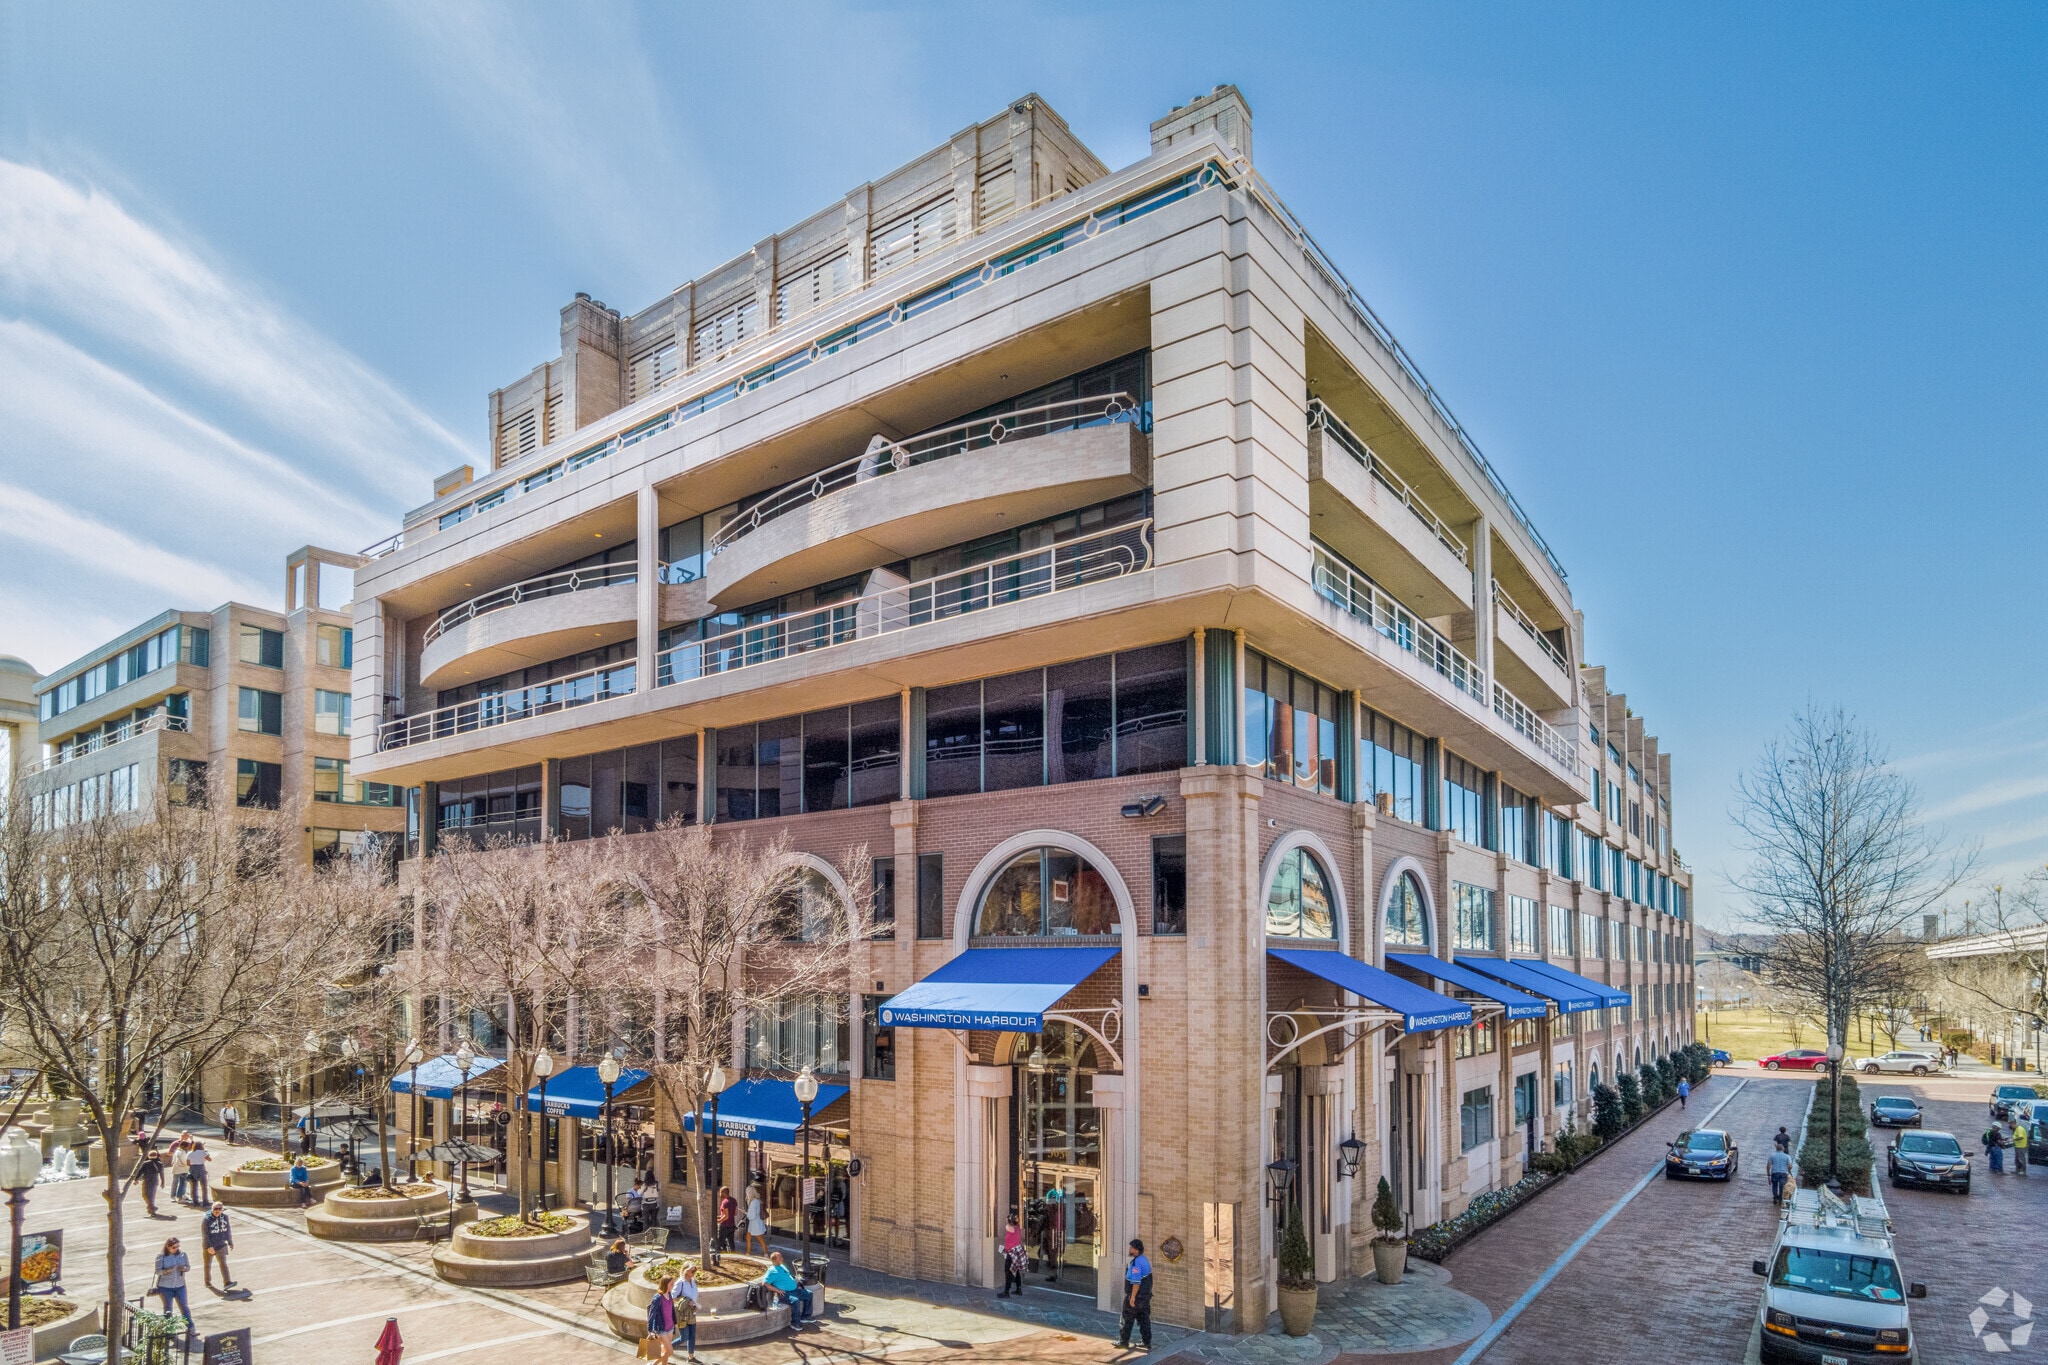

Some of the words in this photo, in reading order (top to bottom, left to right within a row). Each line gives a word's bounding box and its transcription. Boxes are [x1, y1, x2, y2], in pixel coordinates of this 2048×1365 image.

[895, 1012, 971, 1025] WASHINGTON
[974, 1015, 1037, 1027] HARBOUR
[1415, 1015, 1448, 1026] WASHINGTON
[1448, 1011, 1471, 1021] HARBOUR
[543, 1100, 571, 1110] TARBUCKS
[546, 1107, 565, 1116] COFFEE
[718, 1120, 756, 1132] STARBUCKS
[724, 1129, 749, 1138] COFFEE
[0, 1328, 31, 1339] PROHIBITED
